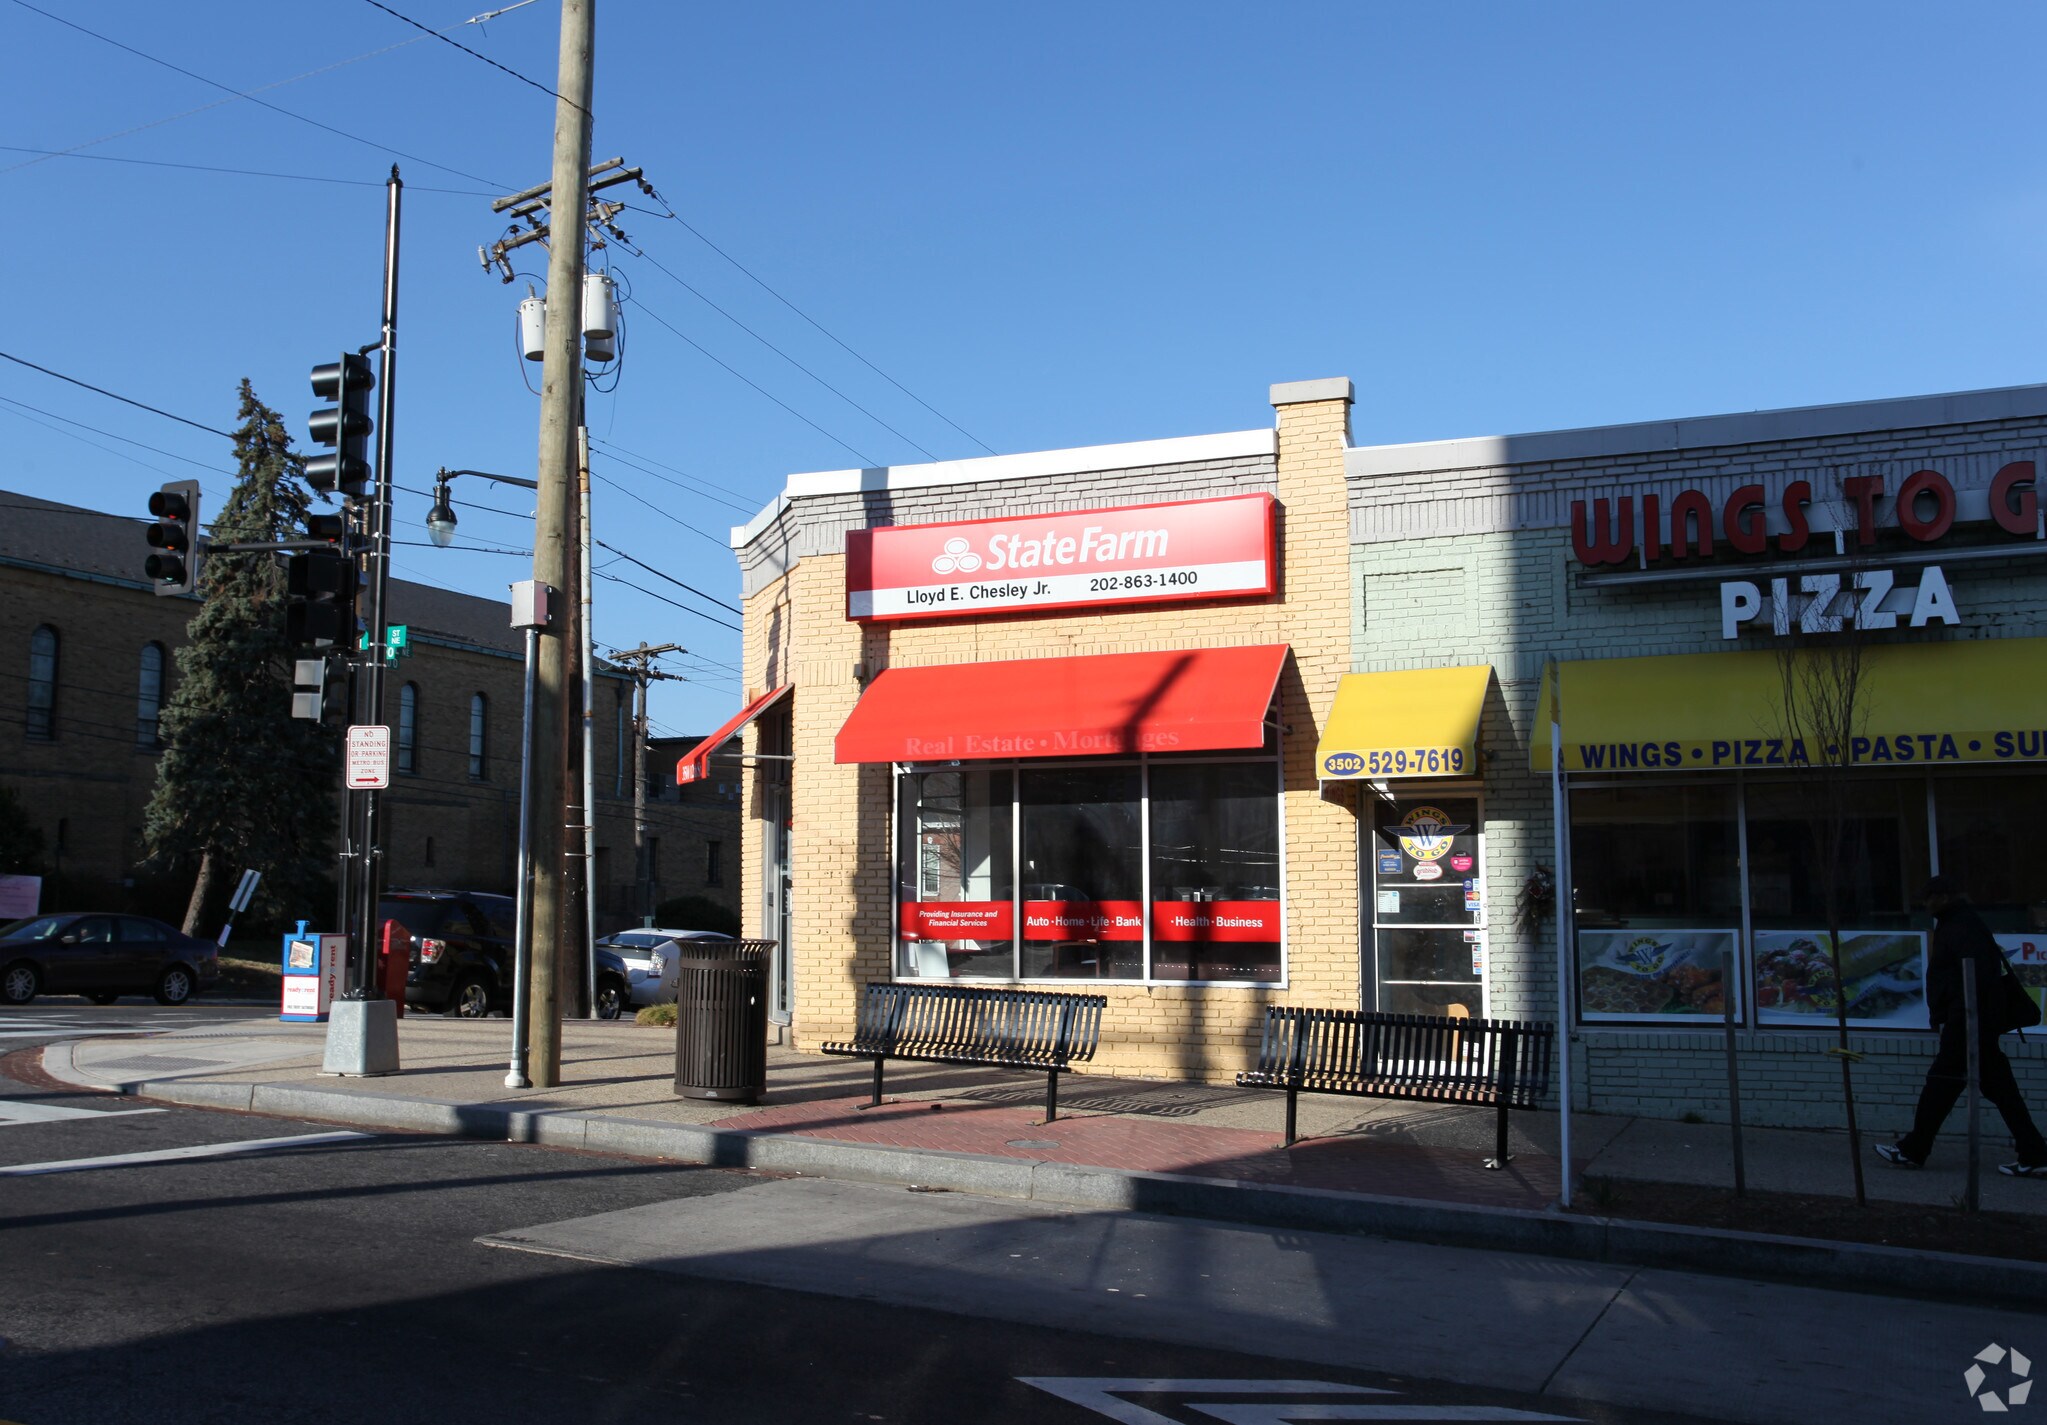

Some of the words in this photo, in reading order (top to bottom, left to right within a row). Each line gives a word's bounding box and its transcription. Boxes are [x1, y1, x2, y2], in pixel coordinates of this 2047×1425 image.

[1570, 480, 1811, 567] WINGS
[1843, 469, 1957, 547] TO
[1090, 571, 1198, 592] 202-863-1400
[907, 587, 945, 606] Lloyd
[951, 587, 964, 601] E.
[970, 582, 1028, 601] Chesley
[1033, 580, 1051, 595] Jr.
[1719, 564, 1962, 641] PIZZA
[391, 629, 401, 637] ST
[391, 637, 401, 645] NE
[364, 730, 374, 738] NO
[351, 740, 386, 748] STANDING
[905, 736, 954, 756] Real
[965, 734, 1035, 754] Estate
[1580, 741, 1683, 769] WINGS
[1712, 738, 1809, 766] PIZZA
[1852, 733, 1960, 762] PASTA
[1328, 757, 1361, 770] 3502
[1368, 747, 1464, 775] 529-7619
[1405, 809, 1448, 825] WINGS
[1414, 823, 1440, 847] W
[1407, 843, 1425, 857] TO
[1431, 840, 1448, 856] GO
[918, 910, 950, 919] Providing
[950, 910, 983, 918] Insurance
[984, 910, 998, 918] and
[928, 919, 959, 927] Financial
[959, 919, 988, 927] Services
[1026, 916, 1050, 927] Auto
[1055, 916, 1085, 927] Home
[1091, 916, 1110, 927] Life
[1115, 916, 1142, 927] Bank
[1175, 915, 1210, 927] Health
[1216, 915, 1263, 928] Business
[329, 945, 337, 967] rent
